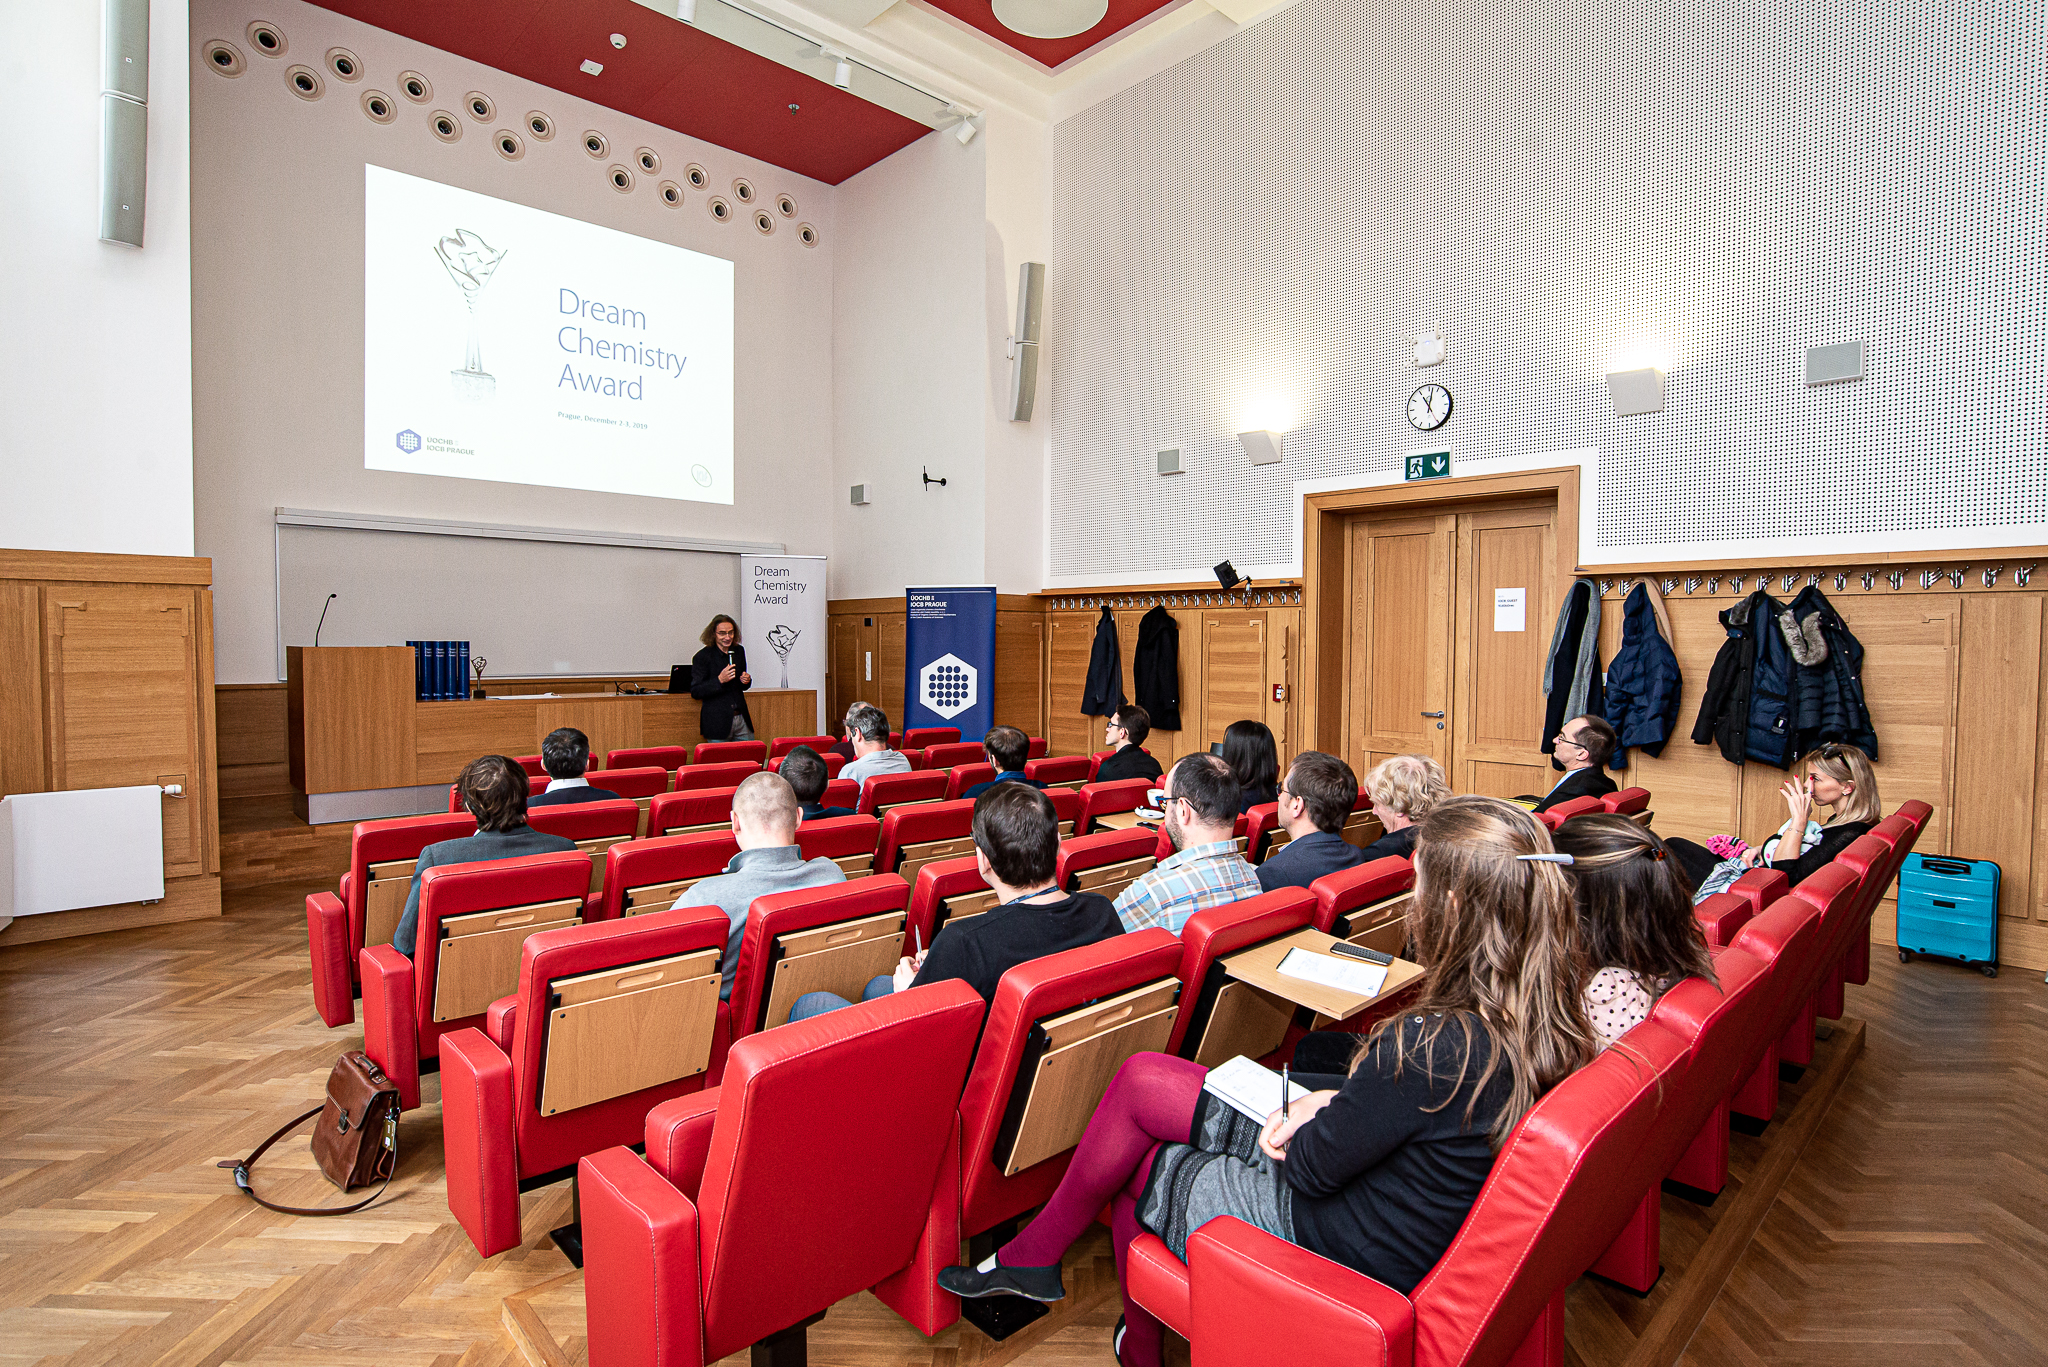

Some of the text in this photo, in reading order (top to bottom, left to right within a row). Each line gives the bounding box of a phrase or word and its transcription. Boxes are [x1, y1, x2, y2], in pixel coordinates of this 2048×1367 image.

[559, 288, 646, 330] Dream
[558, 326, 687, 379] Chemistry
[558, 363, 643, 401] Award
[557, 411, 648, 430] Prague, December 2-3, 2019
[426, 444, 475, 455] IOCB PRAGUE
[754, 565, 790, 577] Dream
[754, 579, 807, 594] Chemistry
[754, 593, 789, 605] Award
